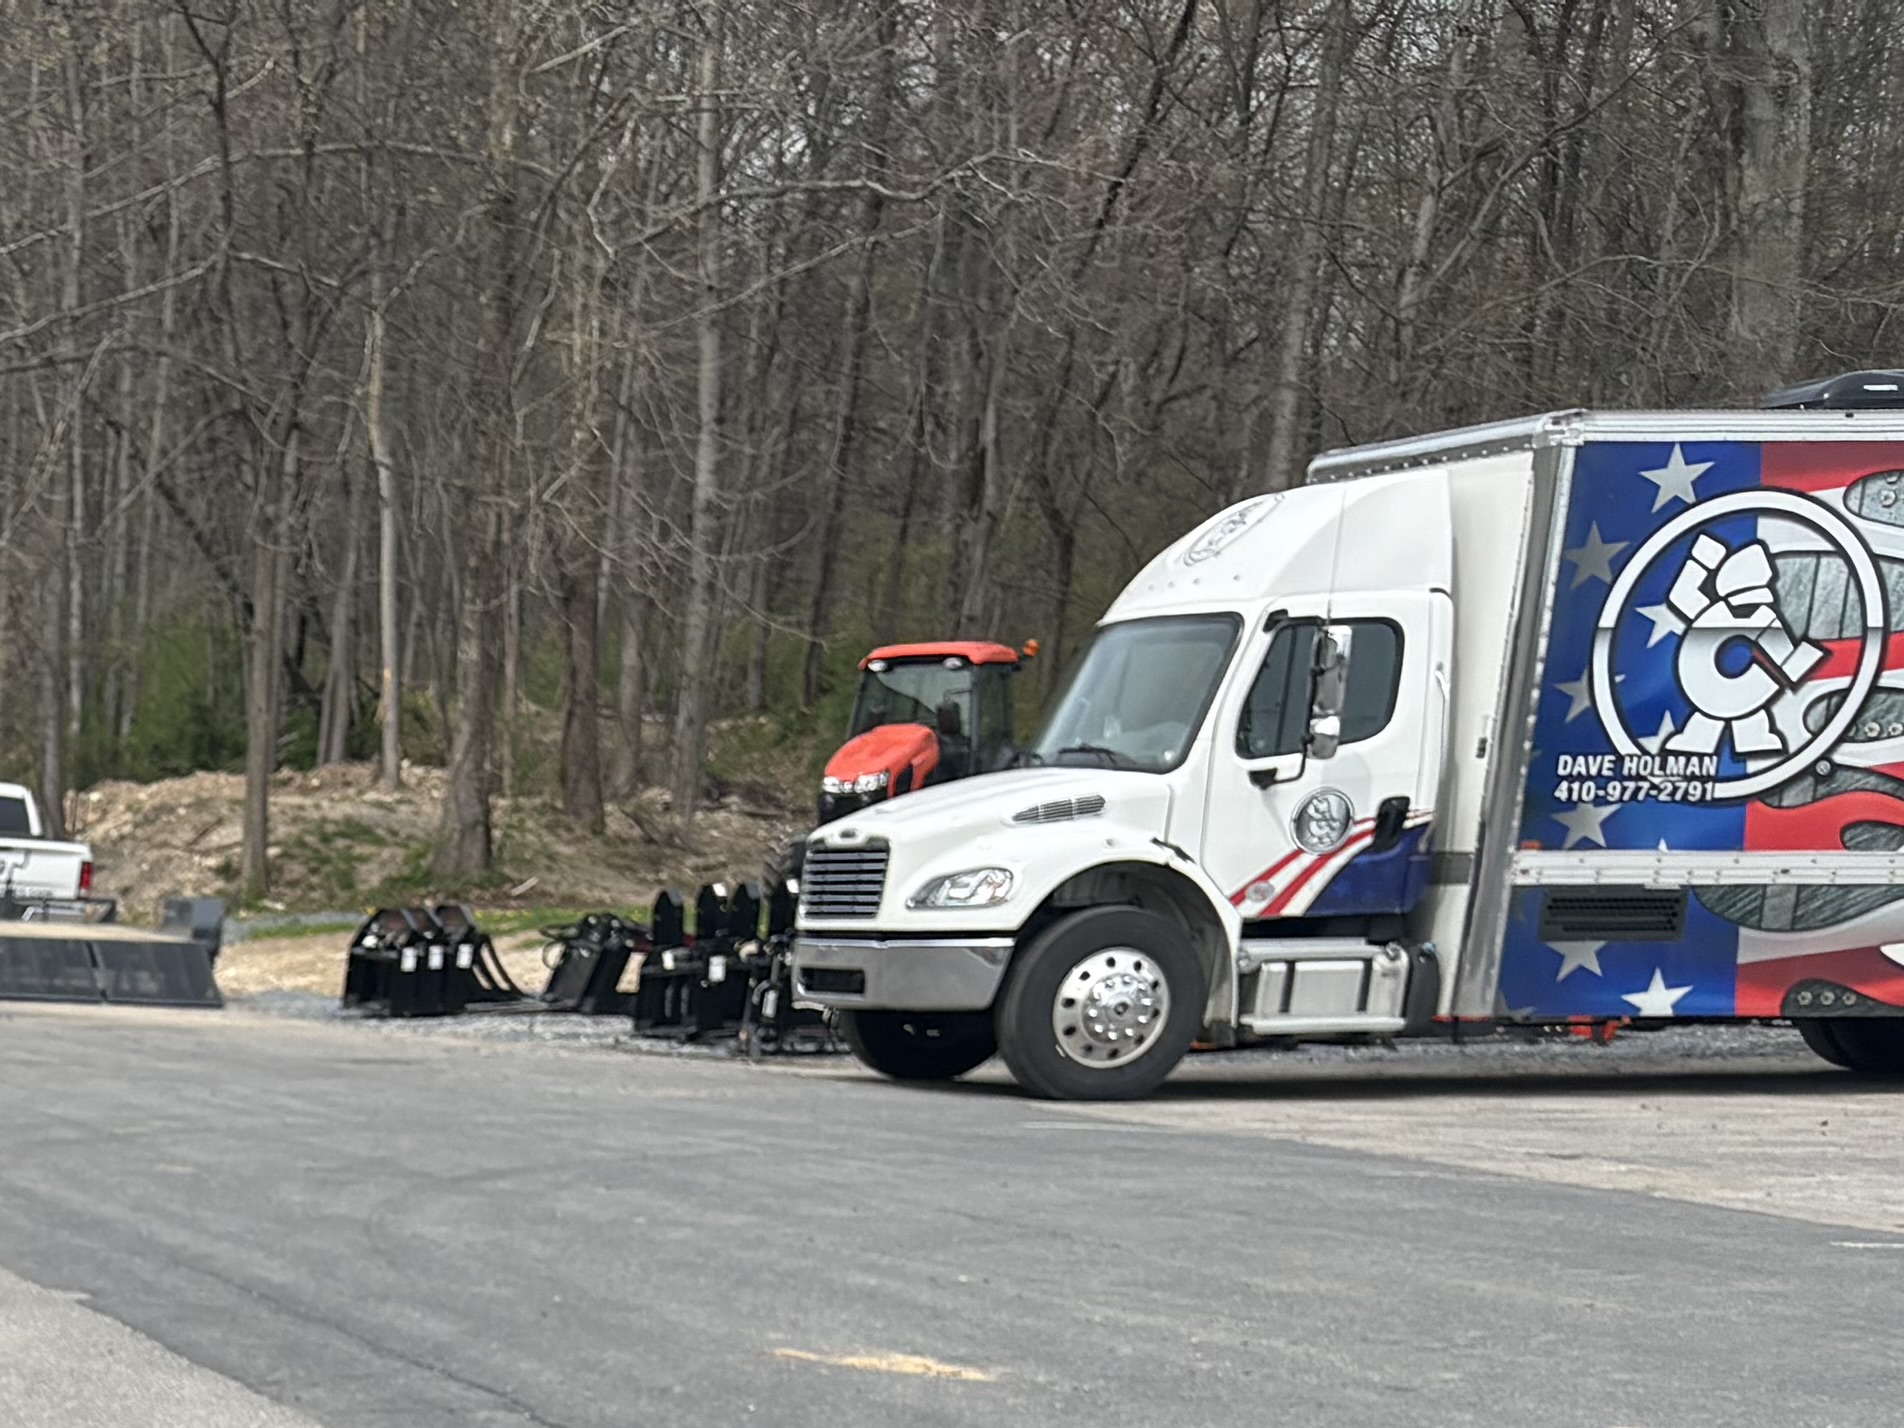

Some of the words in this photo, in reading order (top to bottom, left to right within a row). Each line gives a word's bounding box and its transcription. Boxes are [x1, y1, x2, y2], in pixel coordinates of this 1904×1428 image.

[1556, 755, 1616, 776] DAVE
[1622, 755, 1718, 776] HOLMAN
[1554, 780, 1714, 801] 410-977-2791
